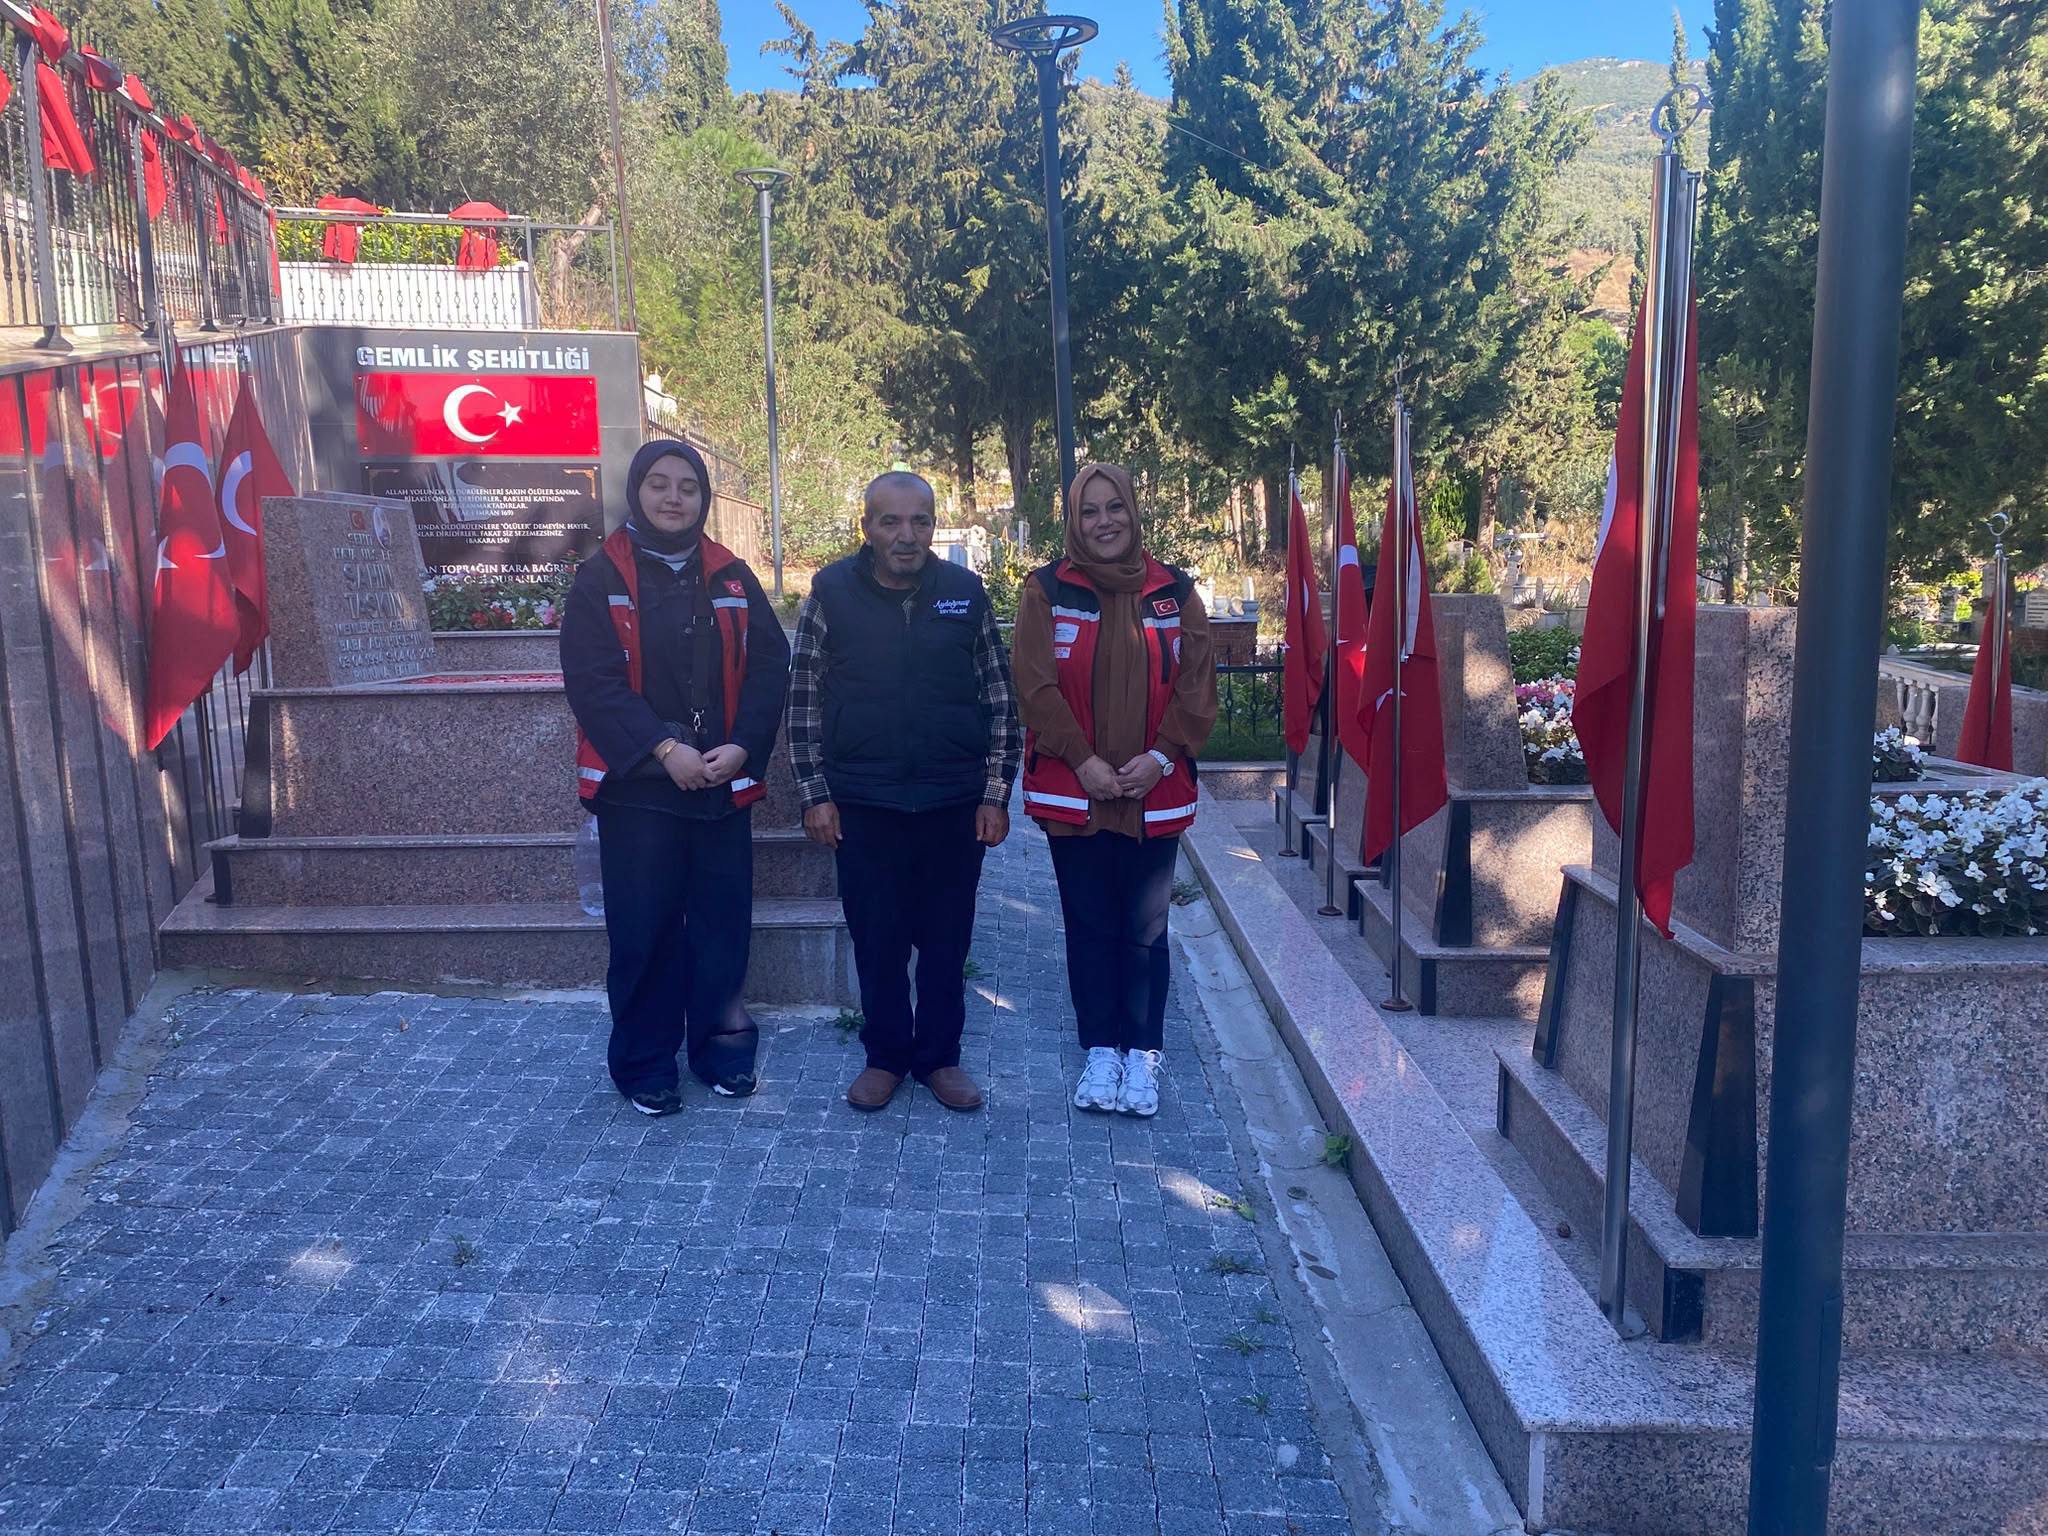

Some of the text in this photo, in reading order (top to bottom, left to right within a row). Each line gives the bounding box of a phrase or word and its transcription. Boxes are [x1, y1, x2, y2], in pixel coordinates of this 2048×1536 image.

[356, 343, 591, 370] GEMLİK ŞEHİTLİĞİ
[385, 488, 409, 496] ALLAH
[409, 488, 446, 496] YOLUNDA
[505, 488, 527, 496] SAKIN
[527, 487, 555, 496] ÖLÜLER
[480, 530, 501, 538] FAKAT
[497, 537, 510, 545] 154)
[441, 562, 498, 574] TOPRAĞIN
[501, 564, 529, 574] KARA
